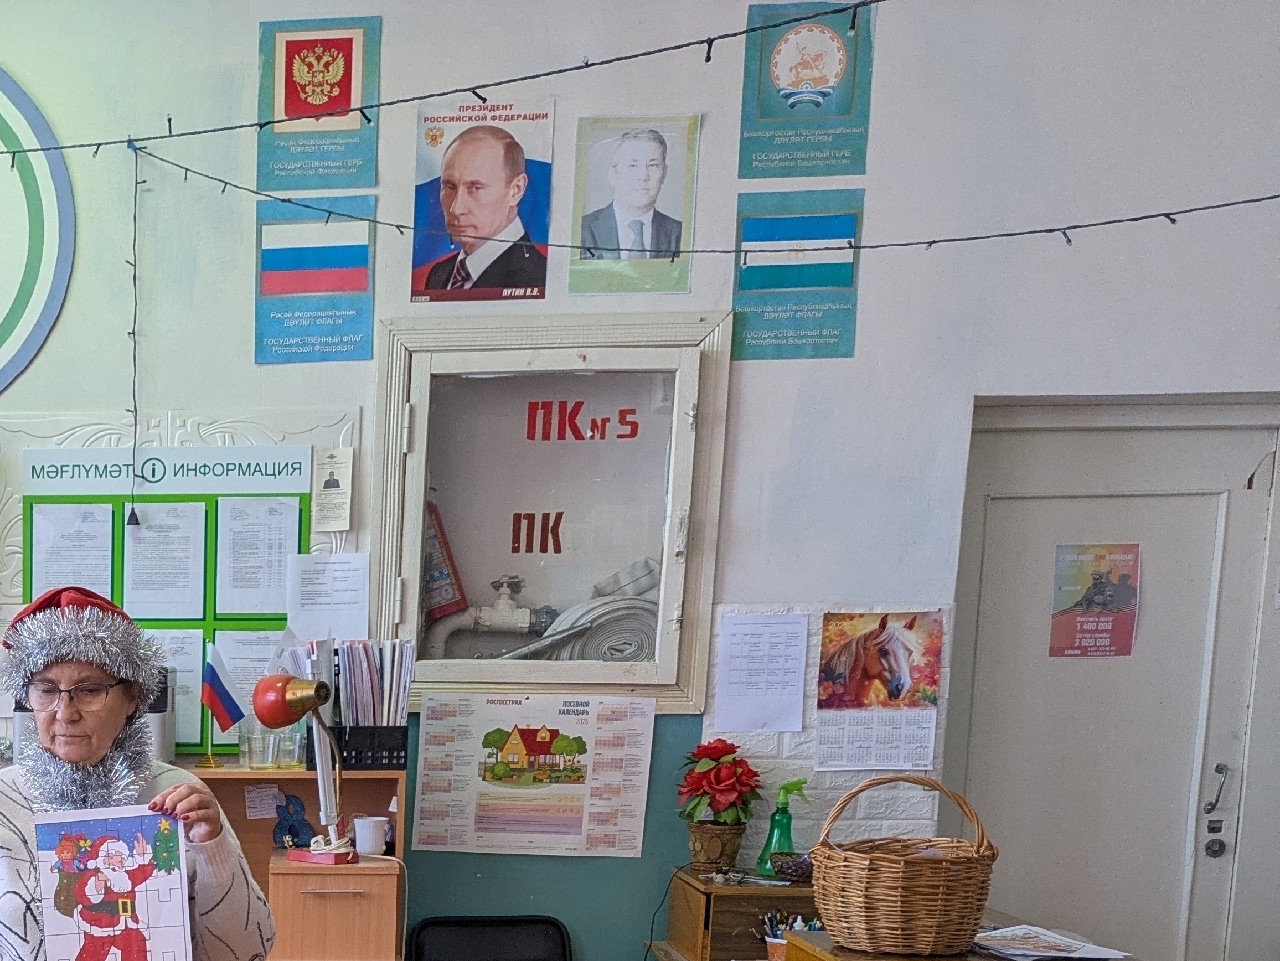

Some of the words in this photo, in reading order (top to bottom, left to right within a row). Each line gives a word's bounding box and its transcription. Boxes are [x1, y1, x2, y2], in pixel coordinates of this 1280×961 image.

[458, 104, 514, 113] ПРЕЗИДЕНТ
[423, 113, 488, 124] РОССИЙСКОЙ
[490, 112, 549, 122] ФЕДЕРАЦИИ
[752, 151, 830, 160] ГОСУДАРСТВЕННЫЙ
[502, 288, 525, 297] ПУТИН
[526, 287, 540, 296] В.В.
[742, 329, 820, 338] ГОСУДАРСТВЕННЫЙ
[264, 335, 341, 345] ГОСУДАРСТВЕННЫЙ
[342, 334, 363, 342] ФЛАГ
[526, 400, 586, 441] ПК
[173, 461, 302, 480] ИНФОРМАЦИЯ
[511, 511, 565, 554] ПК
[562, 700, 590, 708] ПОСЕВНОЙ
[558, 708, 590, 716] КАЛЕНДАРЬ
